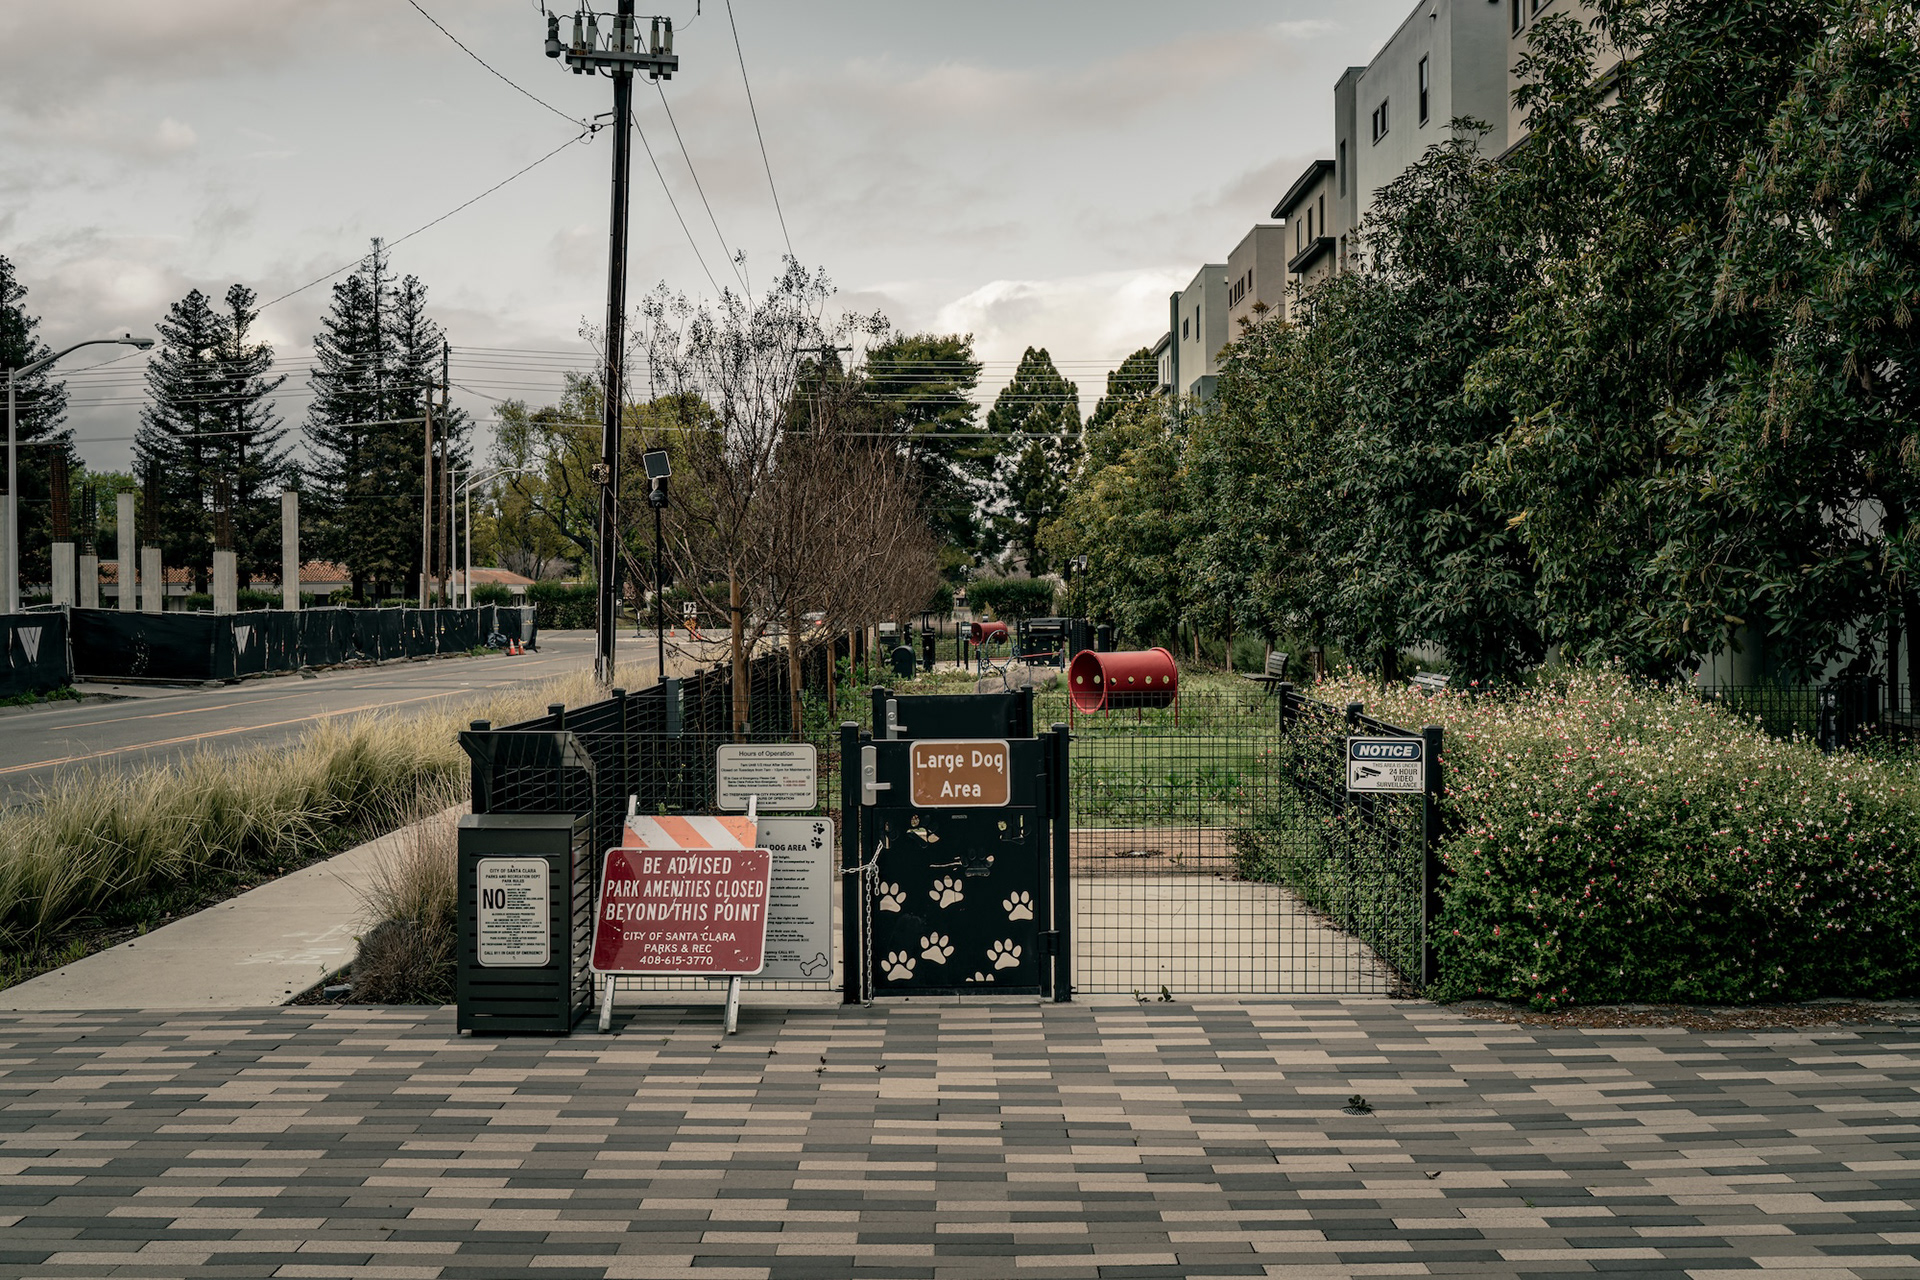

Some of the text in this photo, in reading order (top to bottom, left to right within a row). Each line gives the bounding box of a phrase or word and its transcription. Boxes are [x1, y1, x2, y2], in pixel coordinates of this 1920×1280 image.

[1358, 745, 1414, 756] NOTICE
[917, 750, 1003, 773] Large Dog
[940, 781, 981, 798] Area
[643, 857, 732, 874] BE ADVISED
[606, 880, 764, 898] PARK AMENITIES CLOSED
[483, 889, 505, 909] NO
[606, 903, 760, 921] BEYOND THIS POINT
[623, 932, 736, 941] CITY OF SANTA CLARA
[644, 944, 712, 953] PARKS & REC
[640, 956, 713, 965] 408-615-3770
